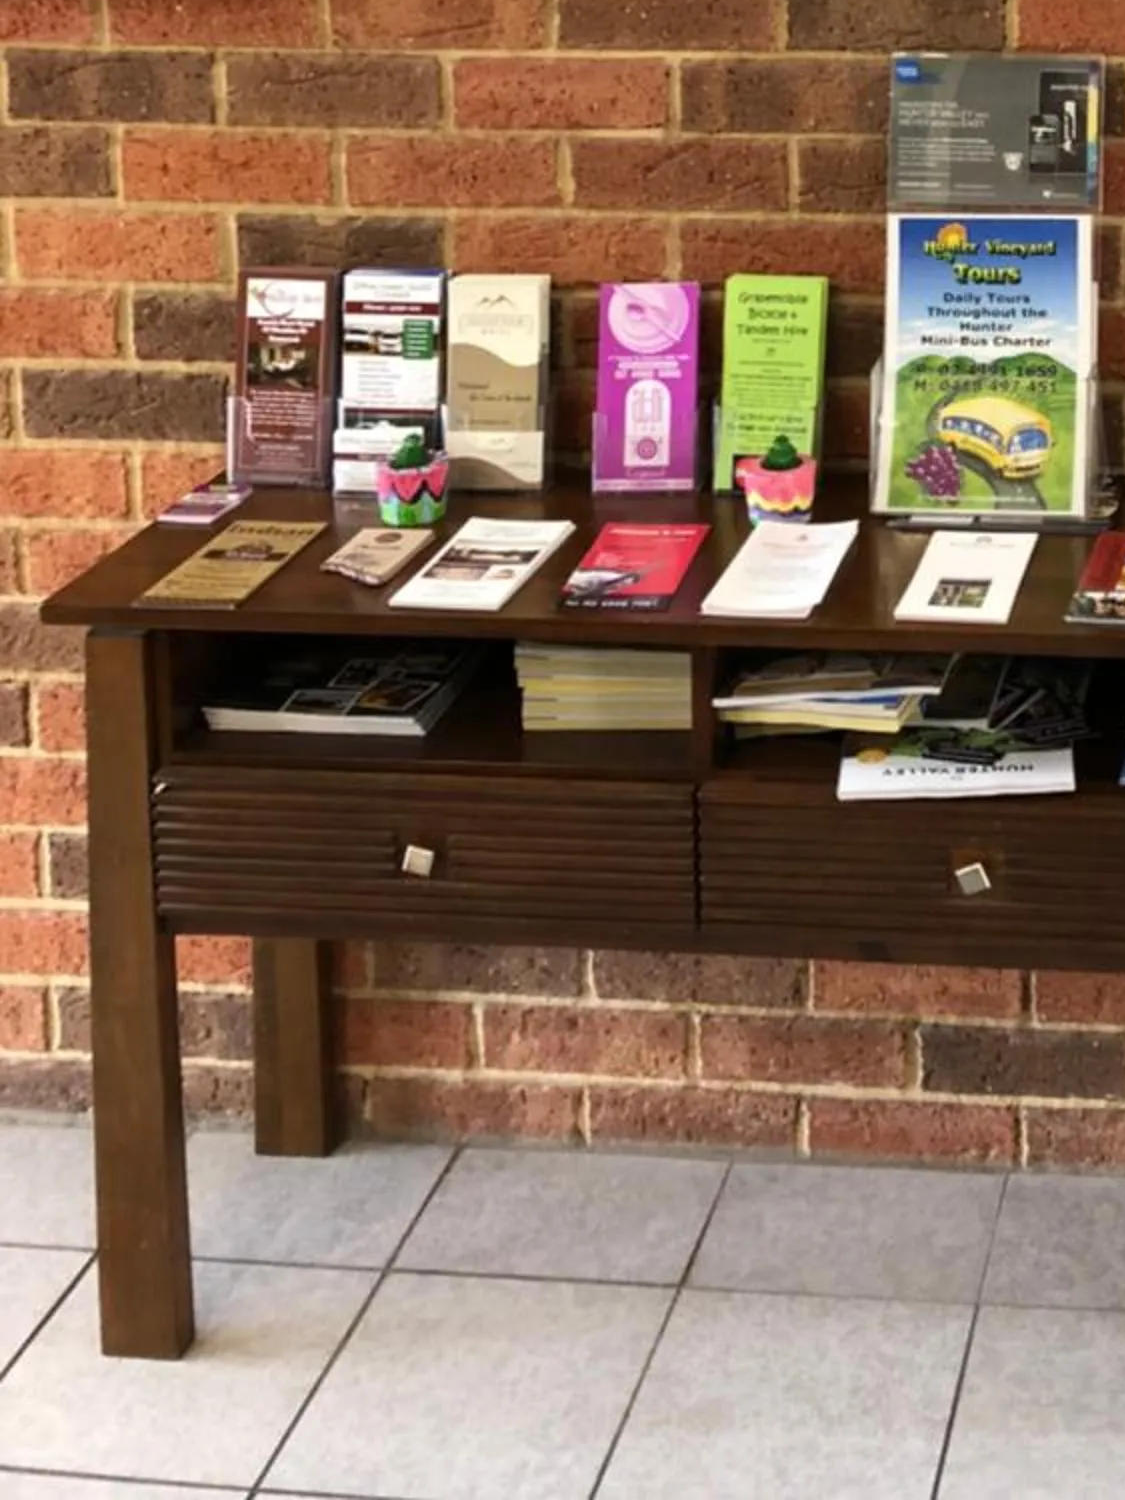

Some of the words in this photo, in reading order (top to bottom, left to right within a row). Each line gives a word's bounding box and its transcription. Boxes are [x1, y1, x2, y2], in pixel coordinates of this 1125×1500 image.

[952, 263, 1022, 286] Tours
[943, 291, 981, 305] Daily
[986, 291, 1031, 304] Tours
[927, 306, 1017, 319] Throughout
[1021, 307, 1048, 318] the
[960, 322, 1013, 332] Hunter
[920, 335, 988, 346] Mini-Bus
[993, 335, 1053, 347] Charter
